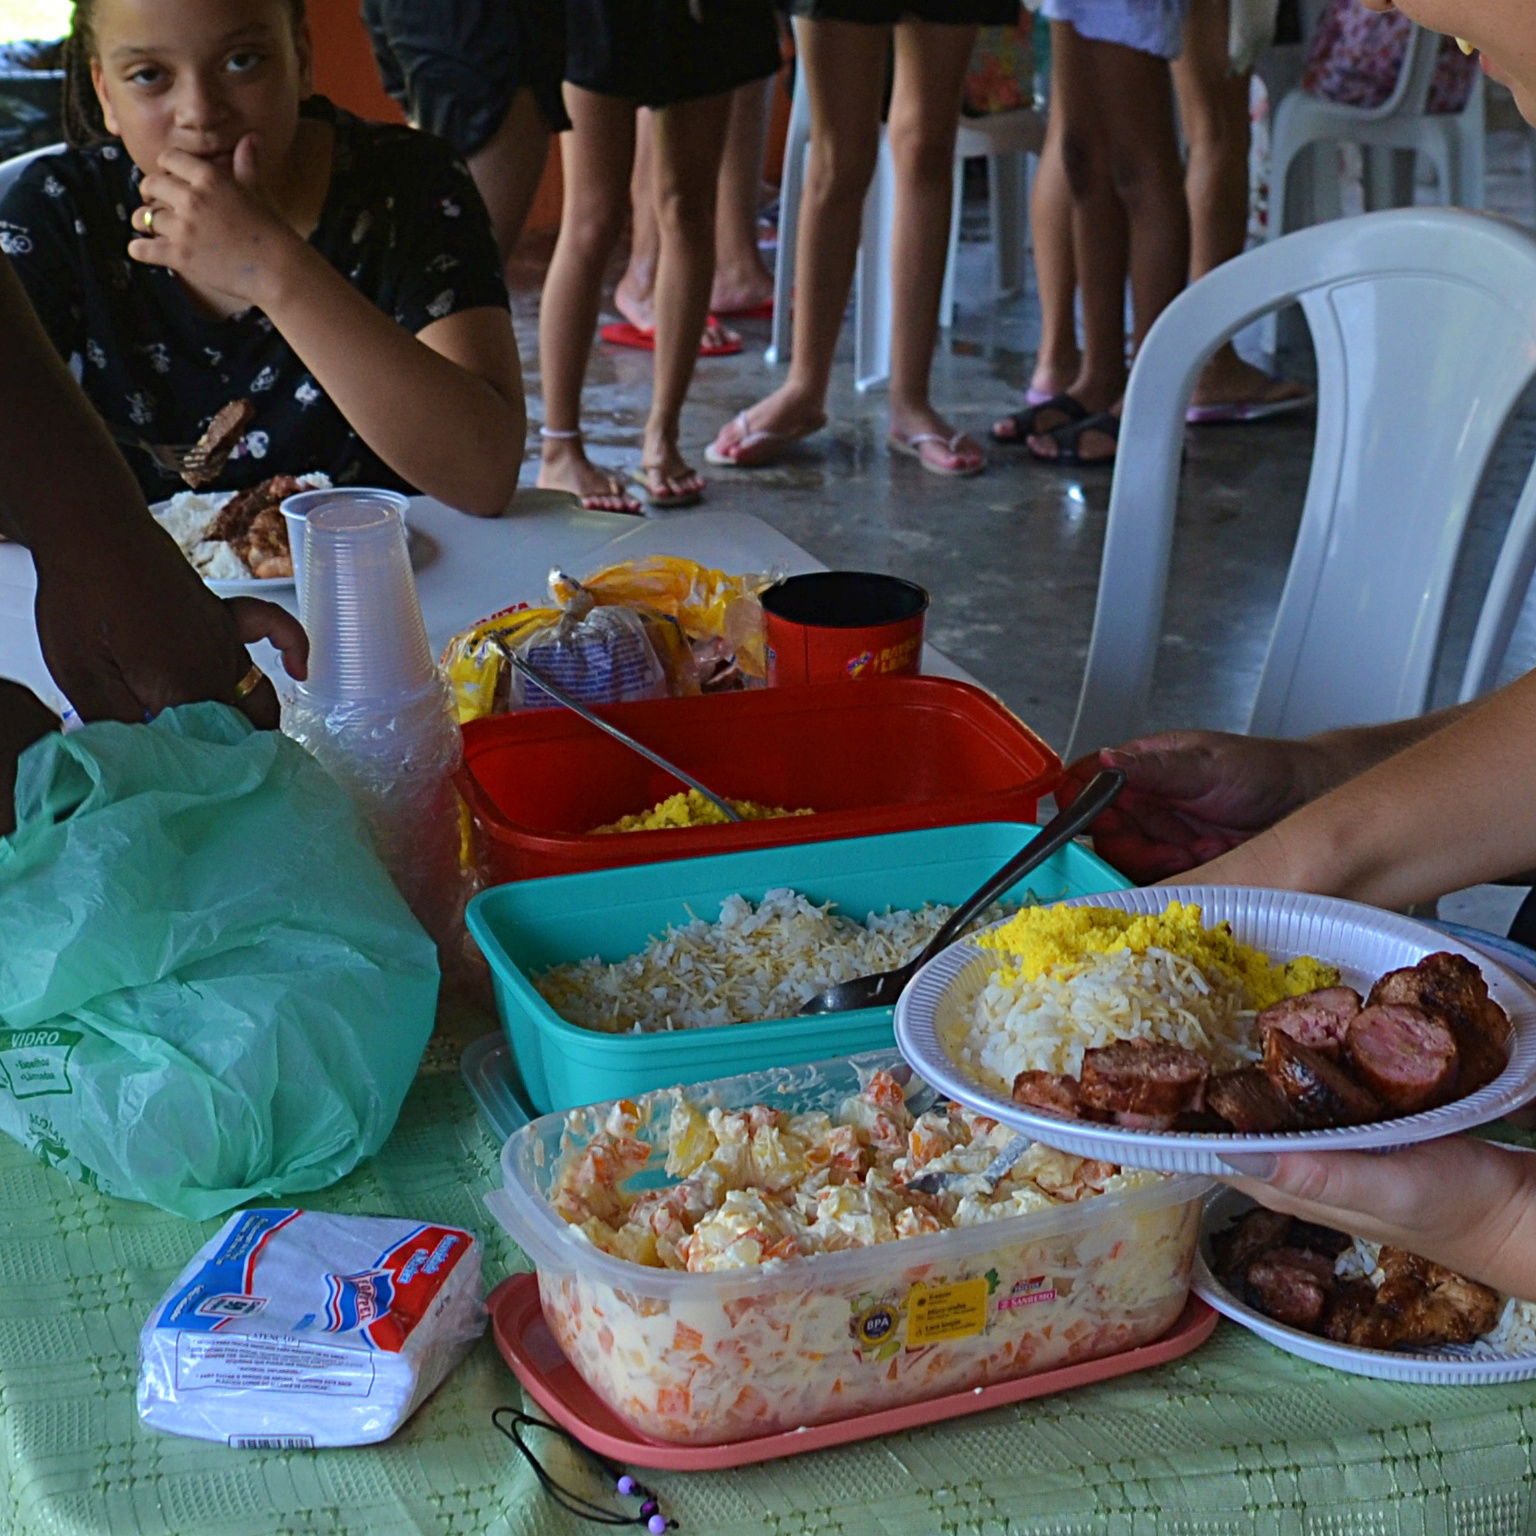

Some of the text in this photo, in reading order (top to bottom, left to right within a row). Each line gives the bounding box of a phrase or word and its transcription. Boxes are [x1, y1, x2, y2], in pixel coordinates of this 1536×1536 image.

[11, 1031, 60, 1047] VIDRO
[1011, 1292, 1054, 1307] SANREMO
[866, 1316, 890, 1331] BPA
